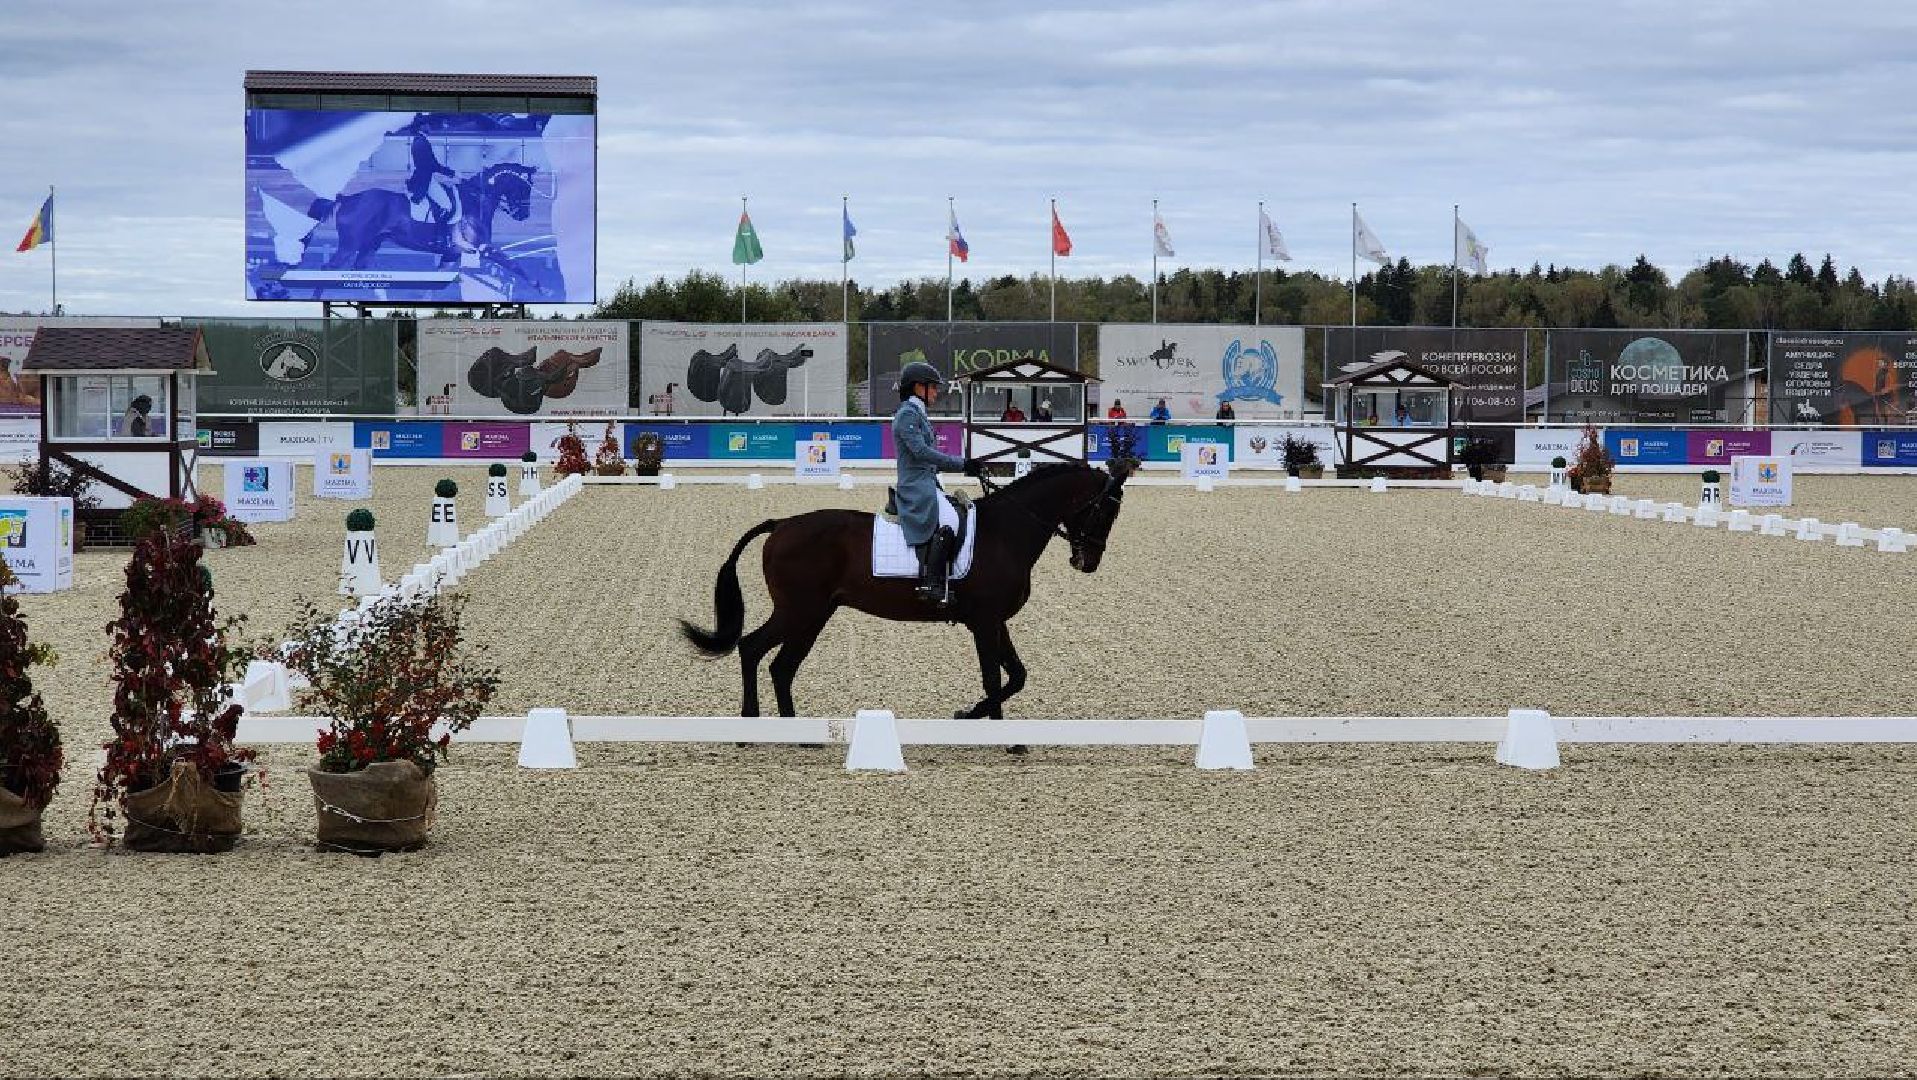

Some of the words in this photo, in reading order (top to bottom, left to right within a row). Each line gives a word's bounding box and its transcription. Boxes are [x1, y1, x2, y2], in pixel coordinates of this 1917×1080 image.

[1421, 352, 1516, 362] КОНЕПЕРЕВОЗКИ
[1441, 362, 1468, 374] ВСЕЙ
[1471, 364, 1516, 374] РОССИИ
[1610, 364, 1729, 381] КОСМЕТИКА
[1570, 379, 1599, 393] DEUS
[1610, 383, 1637, 395] ДЛЯ
[1641, 382, 1708, 395] ЛОШАДЕЙ
[488, 482, 507, 497] SS
[237, 497, 275, 505] MAXIMA
[431, 503, 454, 522] EE
[346, 539, 375, 564] VV
